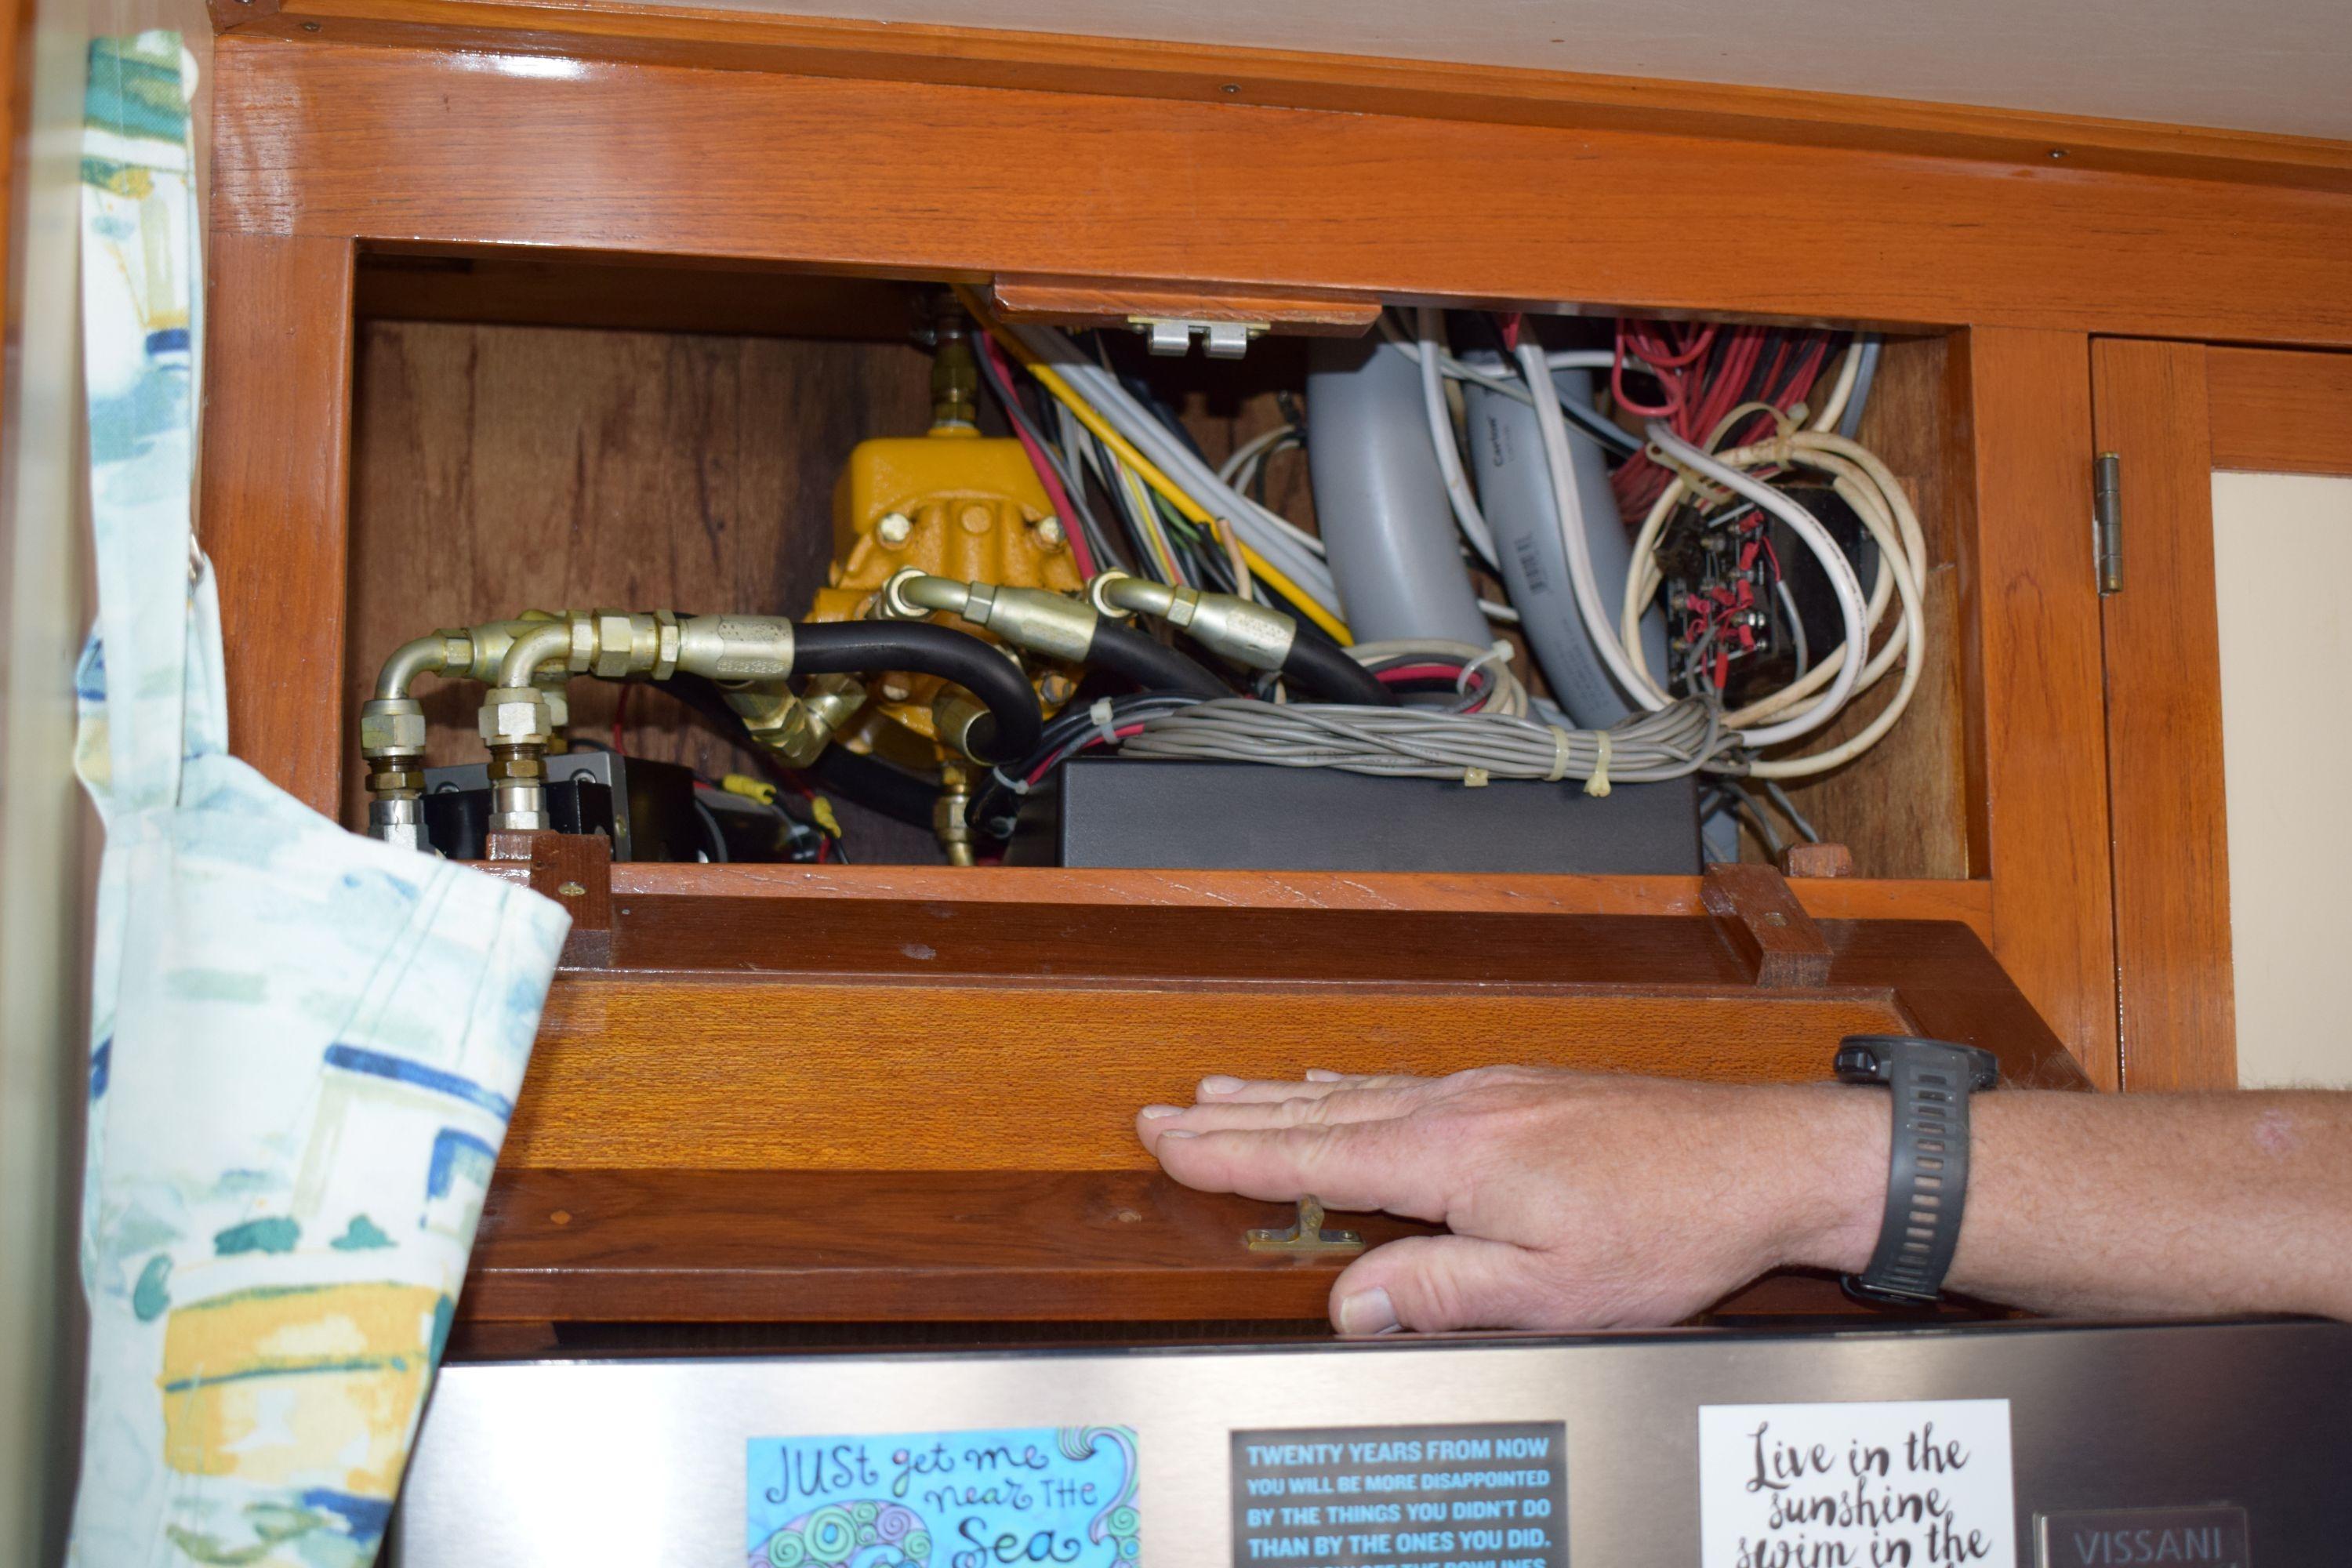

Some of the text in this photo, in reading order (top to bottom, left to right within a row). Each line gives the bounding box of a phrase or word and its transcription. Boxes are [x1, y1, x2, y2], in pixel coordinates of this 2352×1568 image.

[892, 1443, 955, 1498] get
[965, 1445, 1050, 1472] me
[1247, 1438, 1549, 1466] TWENTY YEARS FROM NOW
[1746, 1421, 1971, 1492] Live in the
[924, 1479, 1033, 1512] near
[1247, 1470, 1550, 1496] YOU WILL BE MORE DISAPPOINTED
[1247, 1499, 1552, 1527] BY THE THINGS YOU DIDN'T DO
[1769, 1475, 1951, 1530] sunshine
[953, 1516, 1081, 1568] Sea
[1248, 1528, 1552, 1559] THAN BY THE ONES YOU DID.
[1735, 1511, 1993, 1568] swim in the
[2074, 1527, 2221, 1565] VISSANI
